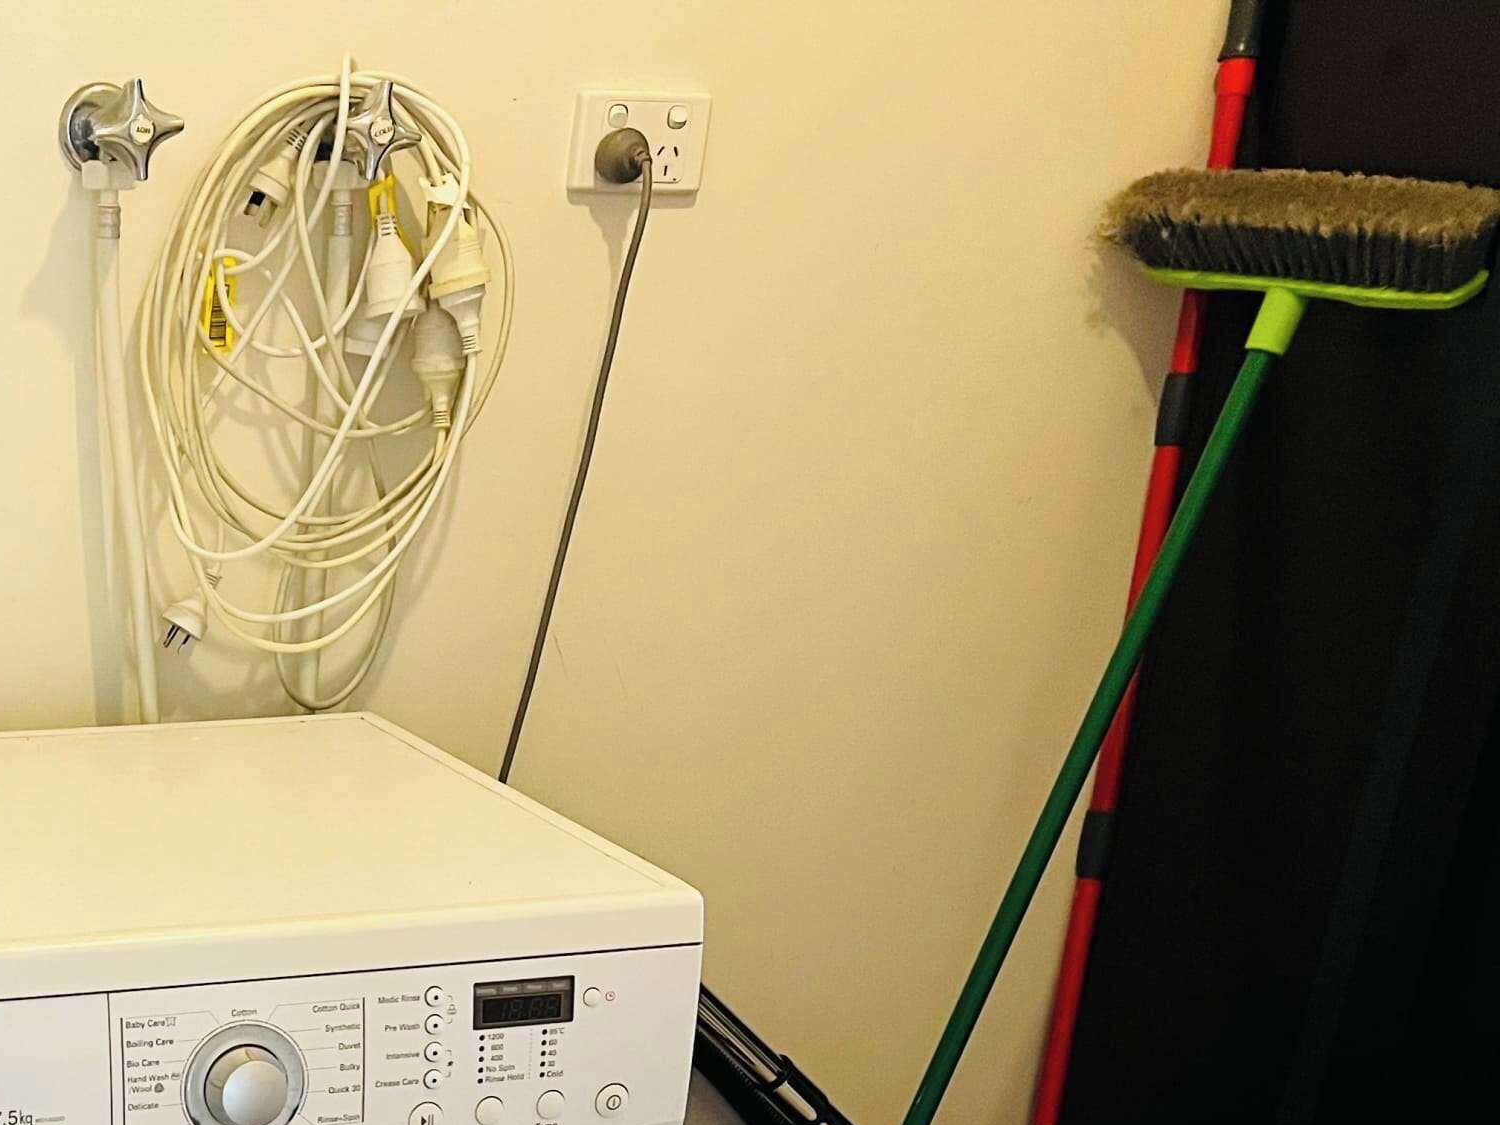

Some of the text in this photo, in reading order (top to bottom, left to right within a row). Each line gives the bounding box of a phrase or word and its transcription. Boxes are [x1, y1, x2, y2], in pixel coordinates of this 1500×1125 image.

[312, 1002, 360, 1013] Cotton Quick
[231, 1008, 257, 1017] Cotton
[125, 1019, 165, 1029] Baby Care
[325, 1024, 361, 1032] Synthetic
[384, 1023, 420, 1032] Pre Wash
[487, 1033, 505, 1041] 1200
[126, 1038, 174, 1048] Boiling Care
[338, 1042, 361, 1051] Duvet
[386, 1052, 420, 1060] Intensive
[126, 1059, 160, 1068] Bio Care
[339, 1063, 361, 1071] Bulky
[485, 1064, 515, 1073] No Spin
[127, 1073, 170, 1083] Hand Wash
[485, 1073, 525, 1083] Rinse Hold
[546, 1070, 564, 1078] Cold
[402, 1077, 420, 1086] Care
[328, 1085, 350, 1094] Quick
[127, 1102, 160, 1111] Delicate
